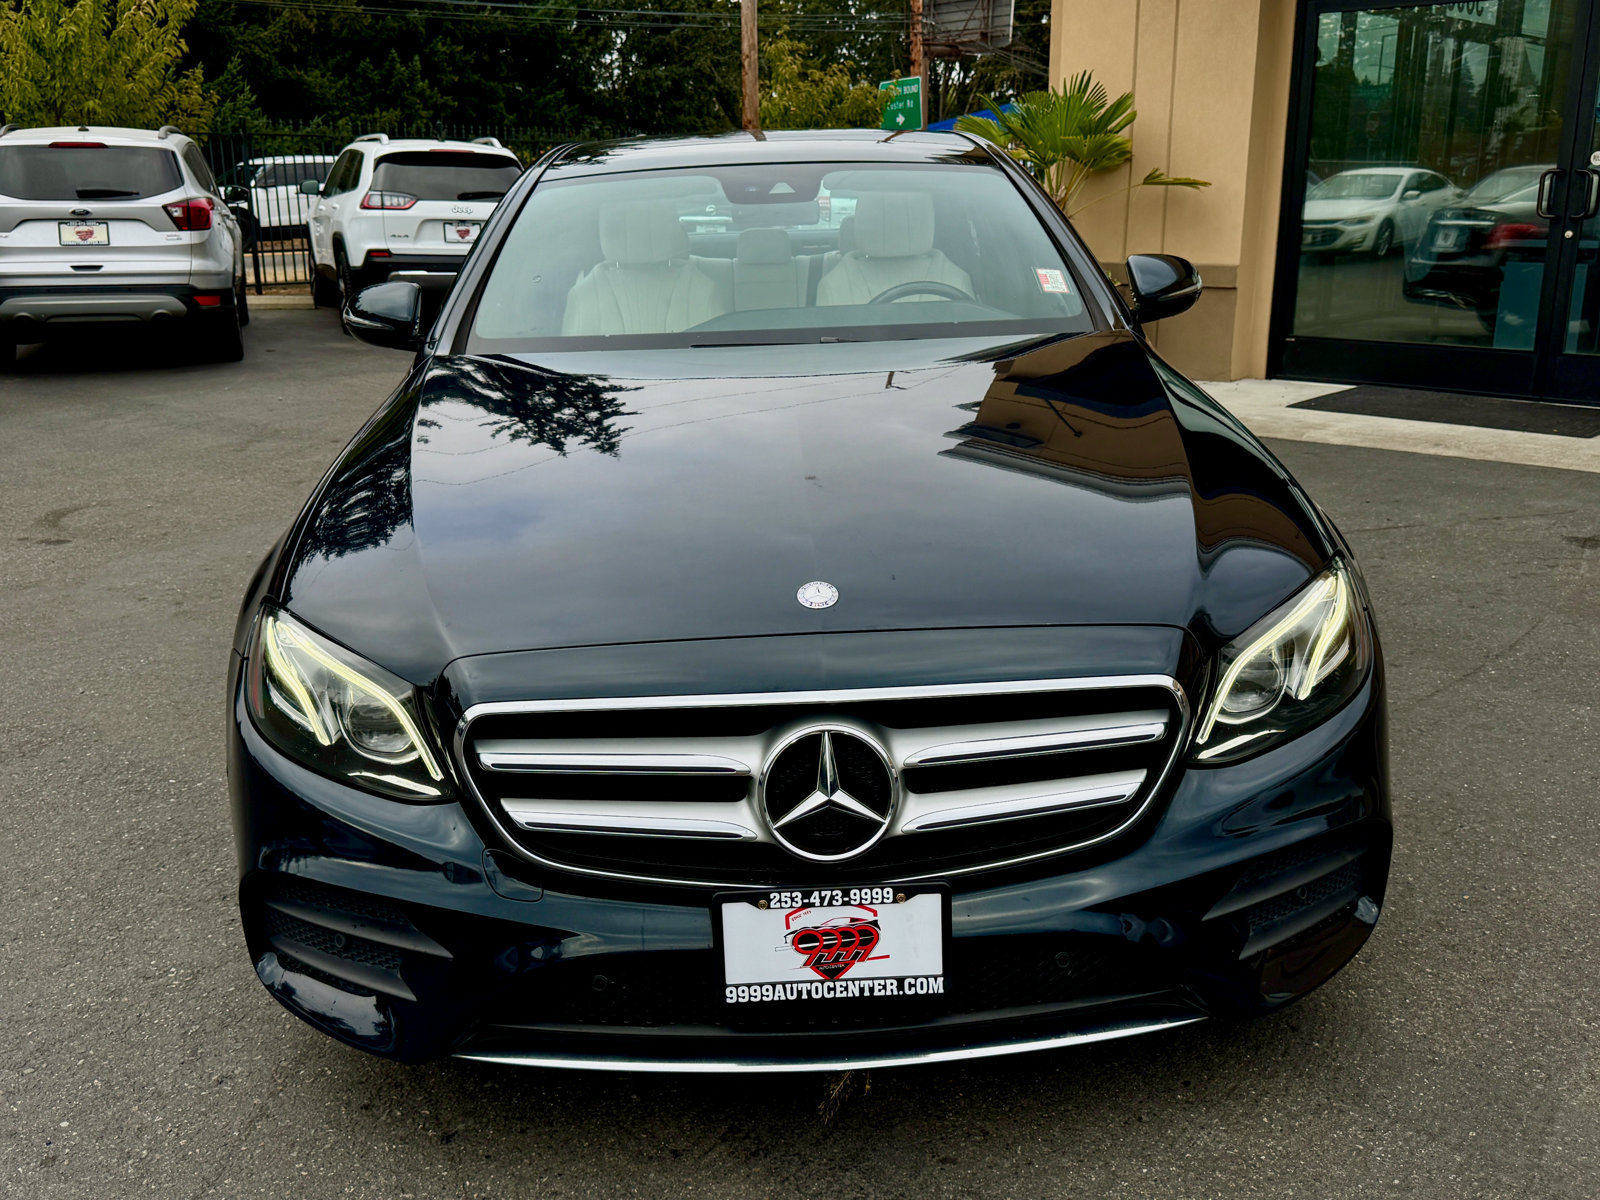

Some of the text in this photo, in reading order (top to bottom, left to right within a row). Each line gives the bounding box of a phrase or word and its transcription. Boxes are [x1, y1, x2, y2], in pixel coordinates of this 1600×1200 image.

[903, 84, 918, 95] BOUND
[769, 887, 894, 909] 253-473-9999
[725, 976, 945, 1004] 9999AUTOCENTER.COM
